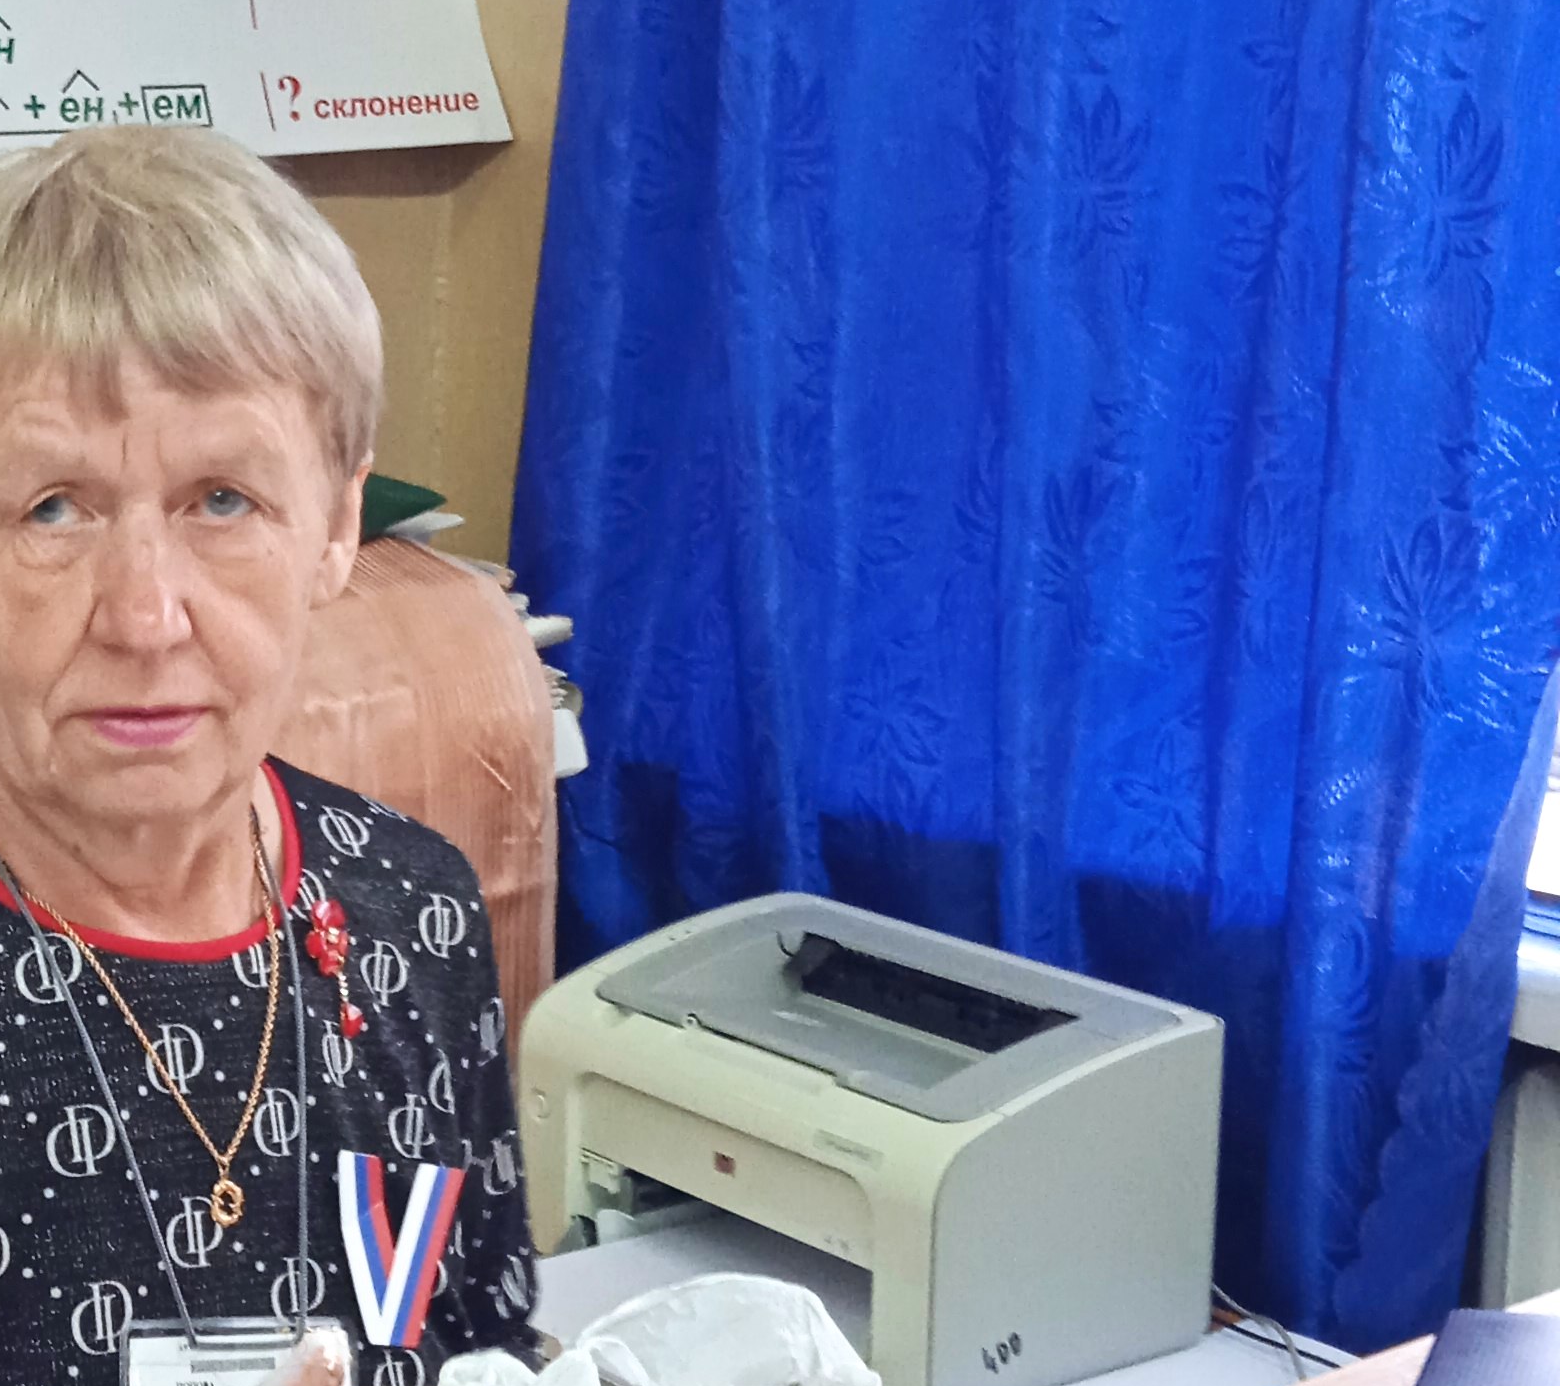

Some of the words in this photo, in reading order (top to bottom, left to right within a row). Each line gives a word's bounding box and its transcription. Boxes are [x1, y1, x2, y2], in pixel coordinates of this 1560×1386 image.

[58, 96, 104, 124] ен
[151, 93, 203, 121] ем
[277, 75, 302, 123] ?
[313, 90, 482, 121] склонение
